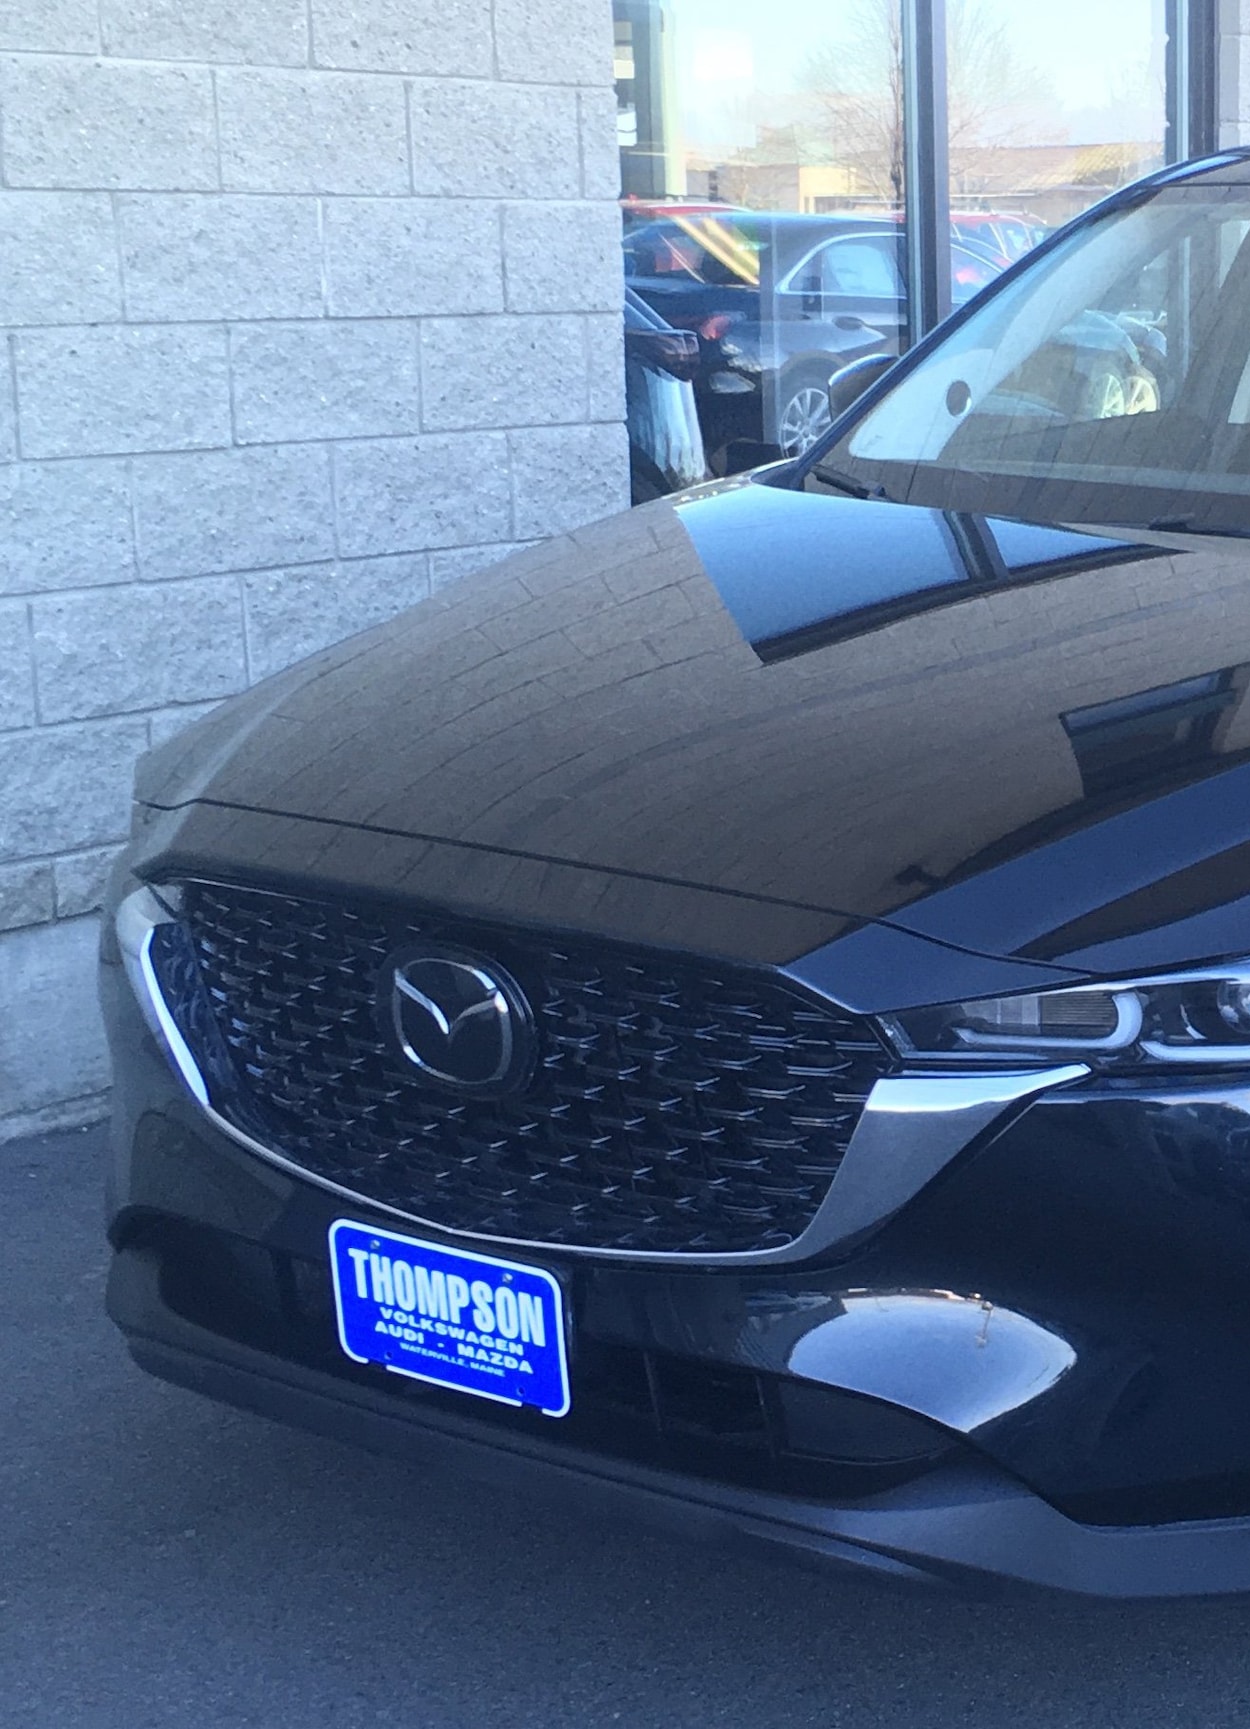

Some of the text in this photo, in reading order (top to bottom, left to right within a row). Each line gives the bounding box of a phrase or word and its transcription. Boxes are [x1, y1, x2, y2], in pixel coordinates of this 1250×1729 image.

[348, 1247, 546, 1347] THOMPSON
[374, 1321, 534, 1374] AUDI MAZDA
[379, 1306, 524, 1356] VOLKSWAGEN
[469, 1361, 506, 1377] MAINE
